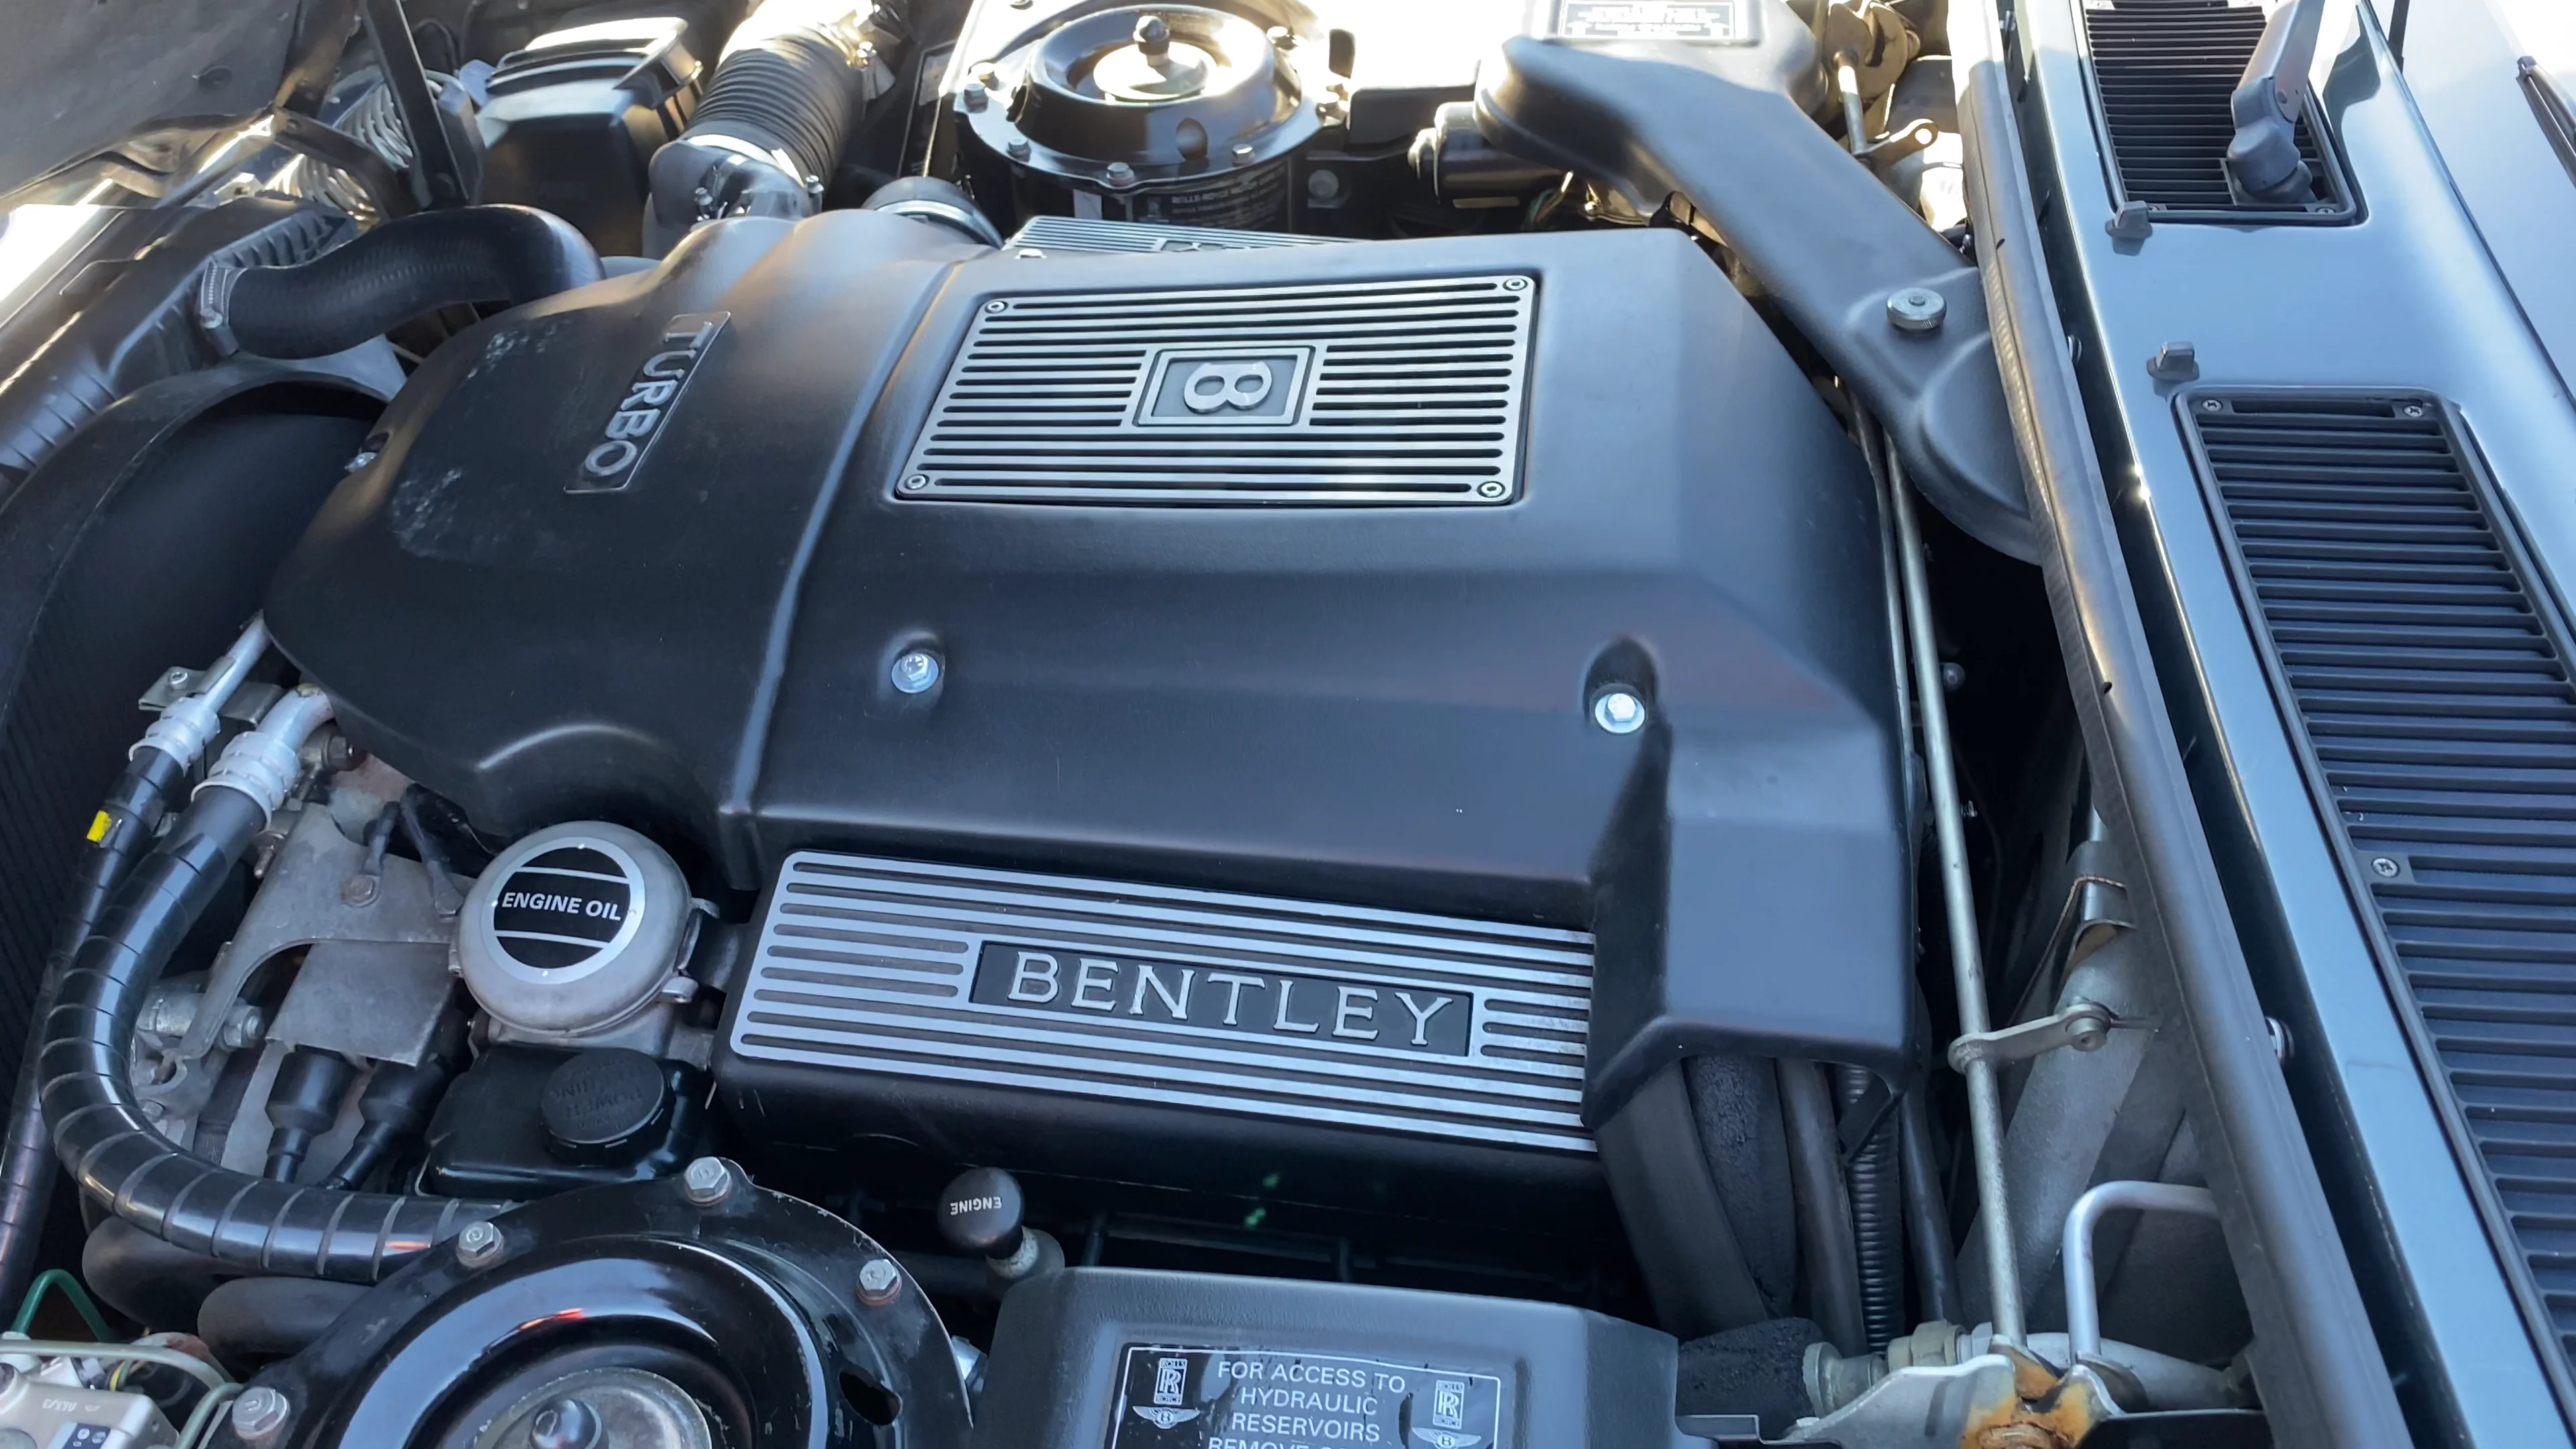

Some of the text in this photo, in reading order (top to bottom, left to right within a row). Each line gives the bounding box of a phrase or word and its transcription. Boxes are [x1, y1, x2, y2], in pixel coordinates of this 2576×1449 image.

[584, 321, 713, 477] TURBO
[502, 892, 621, 921] ENGINE OIL
[1007, 951, 1454, 1046] BENTLEY
[950, 1196, 1002, 1216] ENGINE
[1218, 1362, 1406, 1393] FOR ACCESS TO
[1241, 1387, 1378, 1415] HYDRAULIC
[1232, 1412, 1380, 1442] RESERVOIRS
